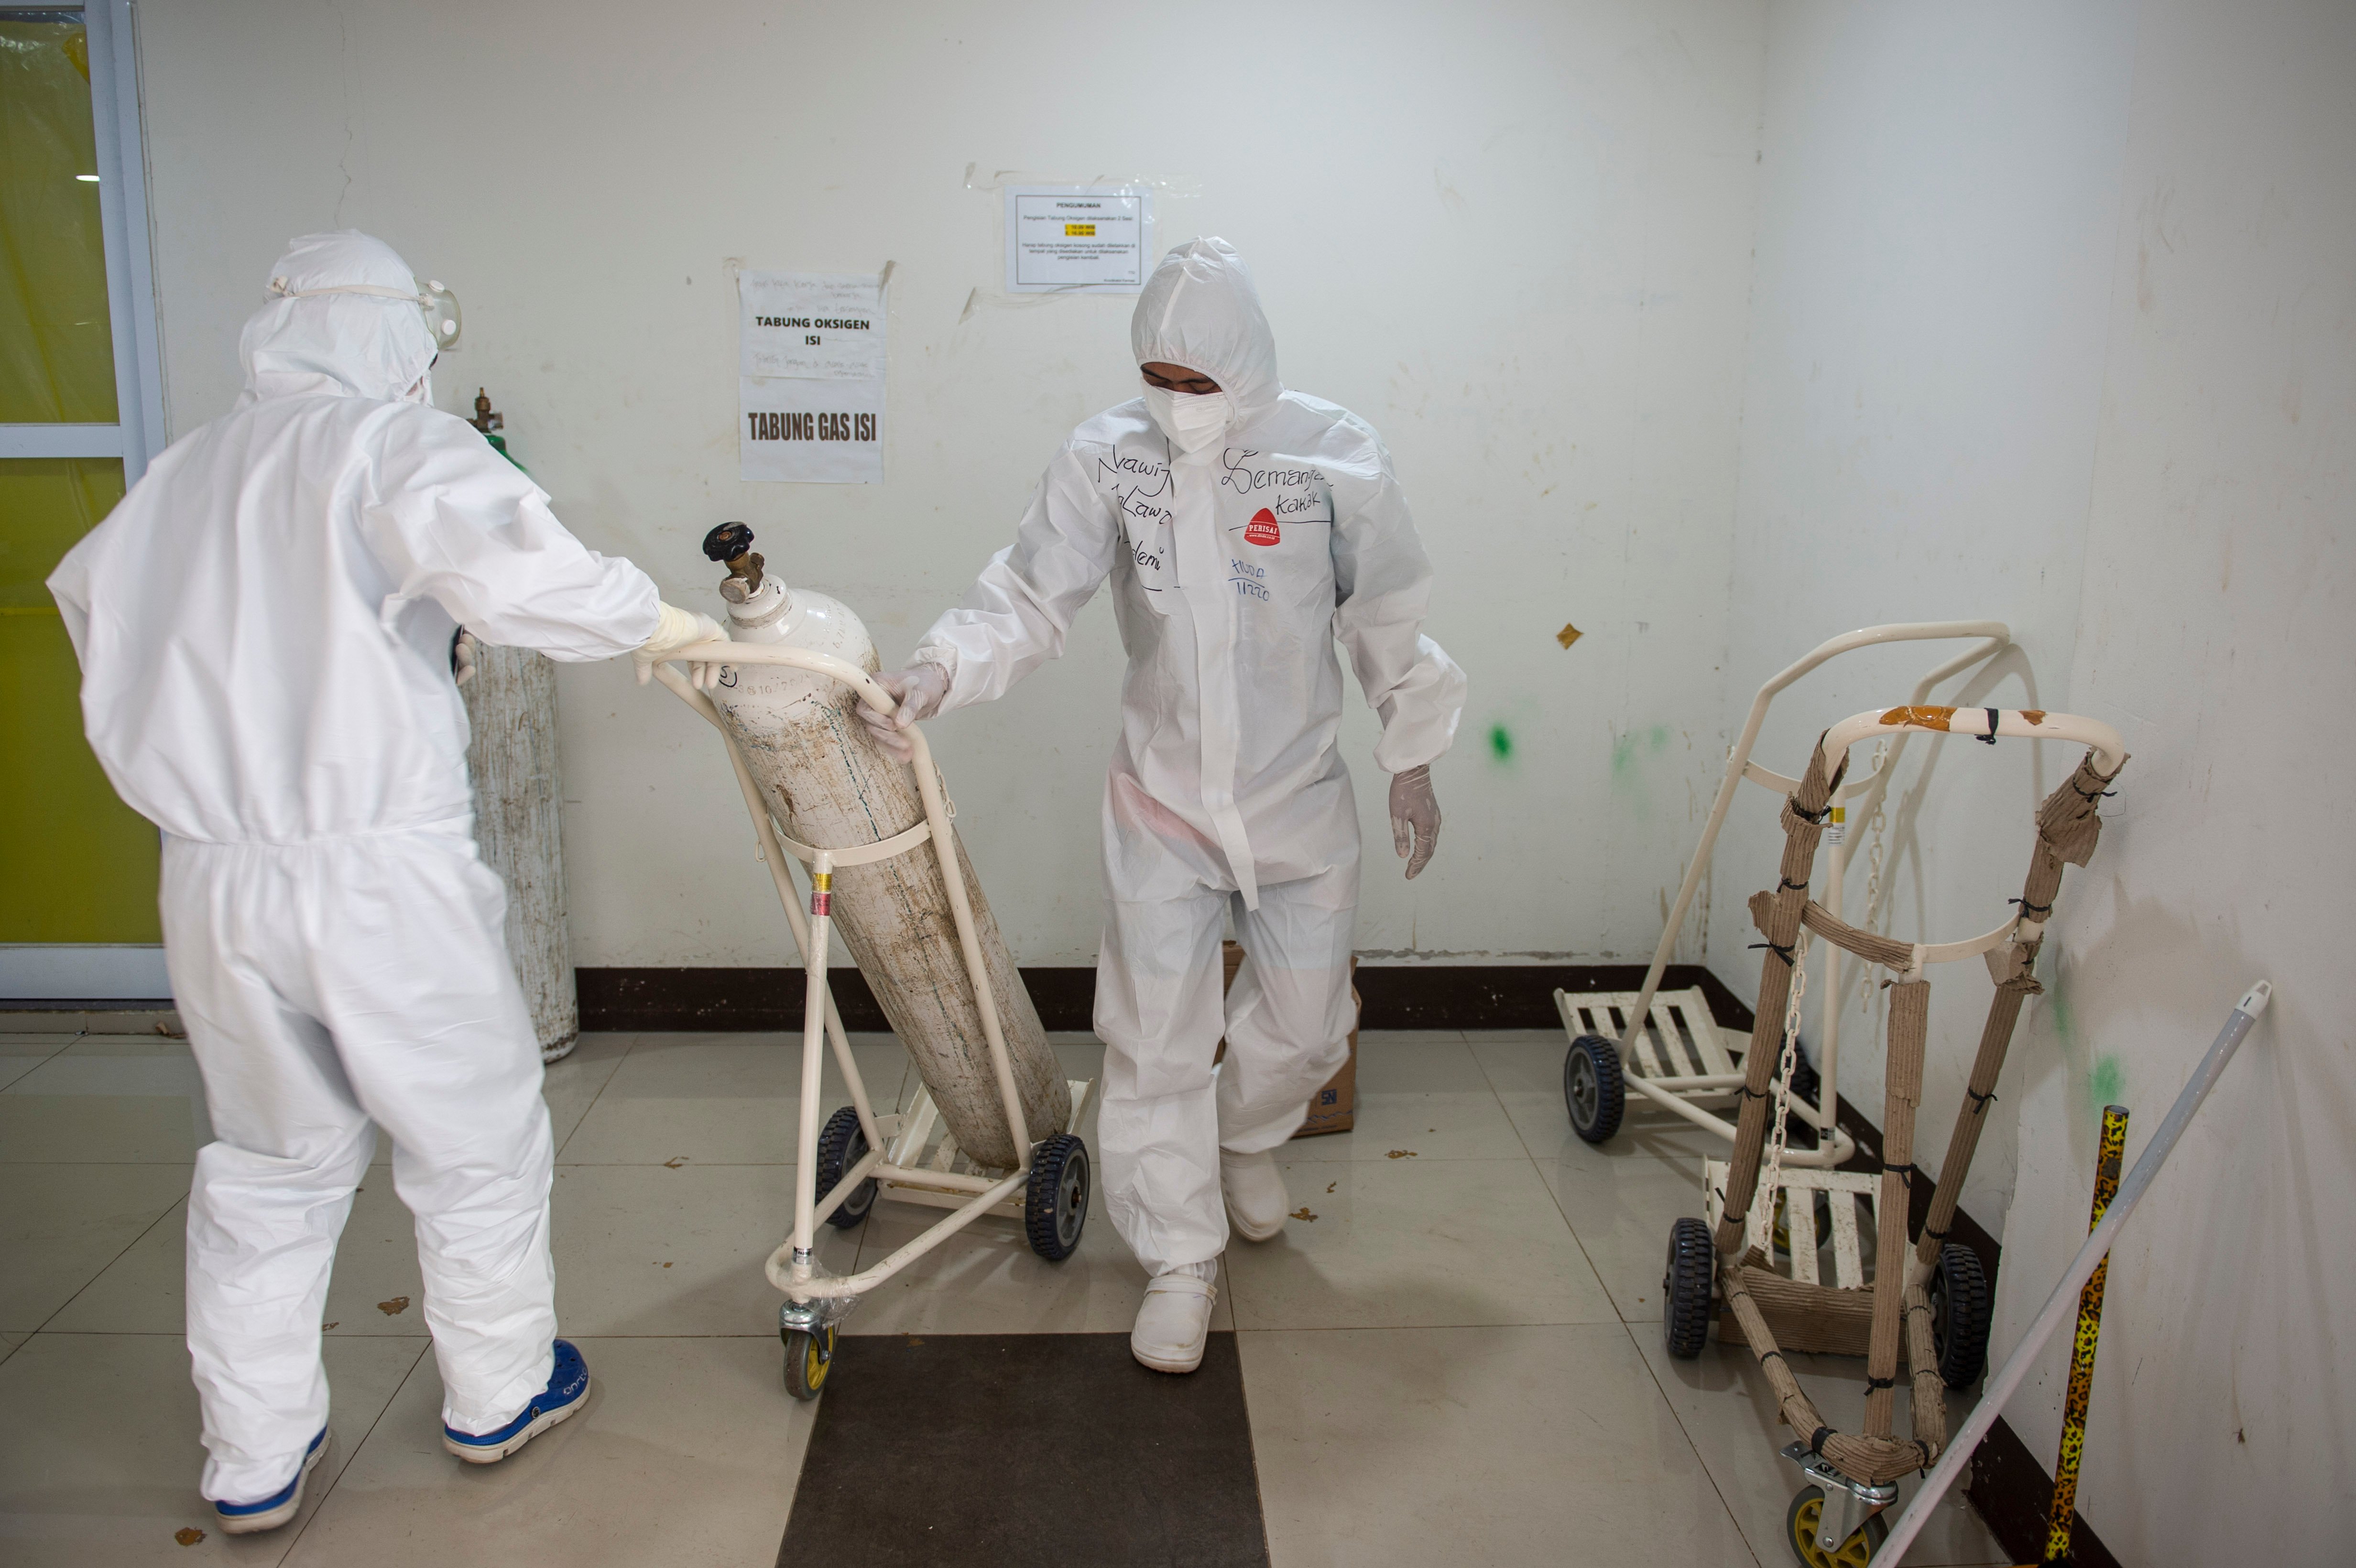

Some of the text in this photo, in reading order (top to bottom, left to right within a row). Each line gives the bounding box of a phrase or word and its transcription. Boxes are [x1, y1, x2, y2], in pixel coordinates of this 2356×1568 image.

[755, 316, 870, 330] TABUNG OKSIGEN
[805, 336, 820, 345] ISI
[748, 413, 876, 441] TABUNG GAS ISI
[1249, 524, 1278, 534] PERISAI
